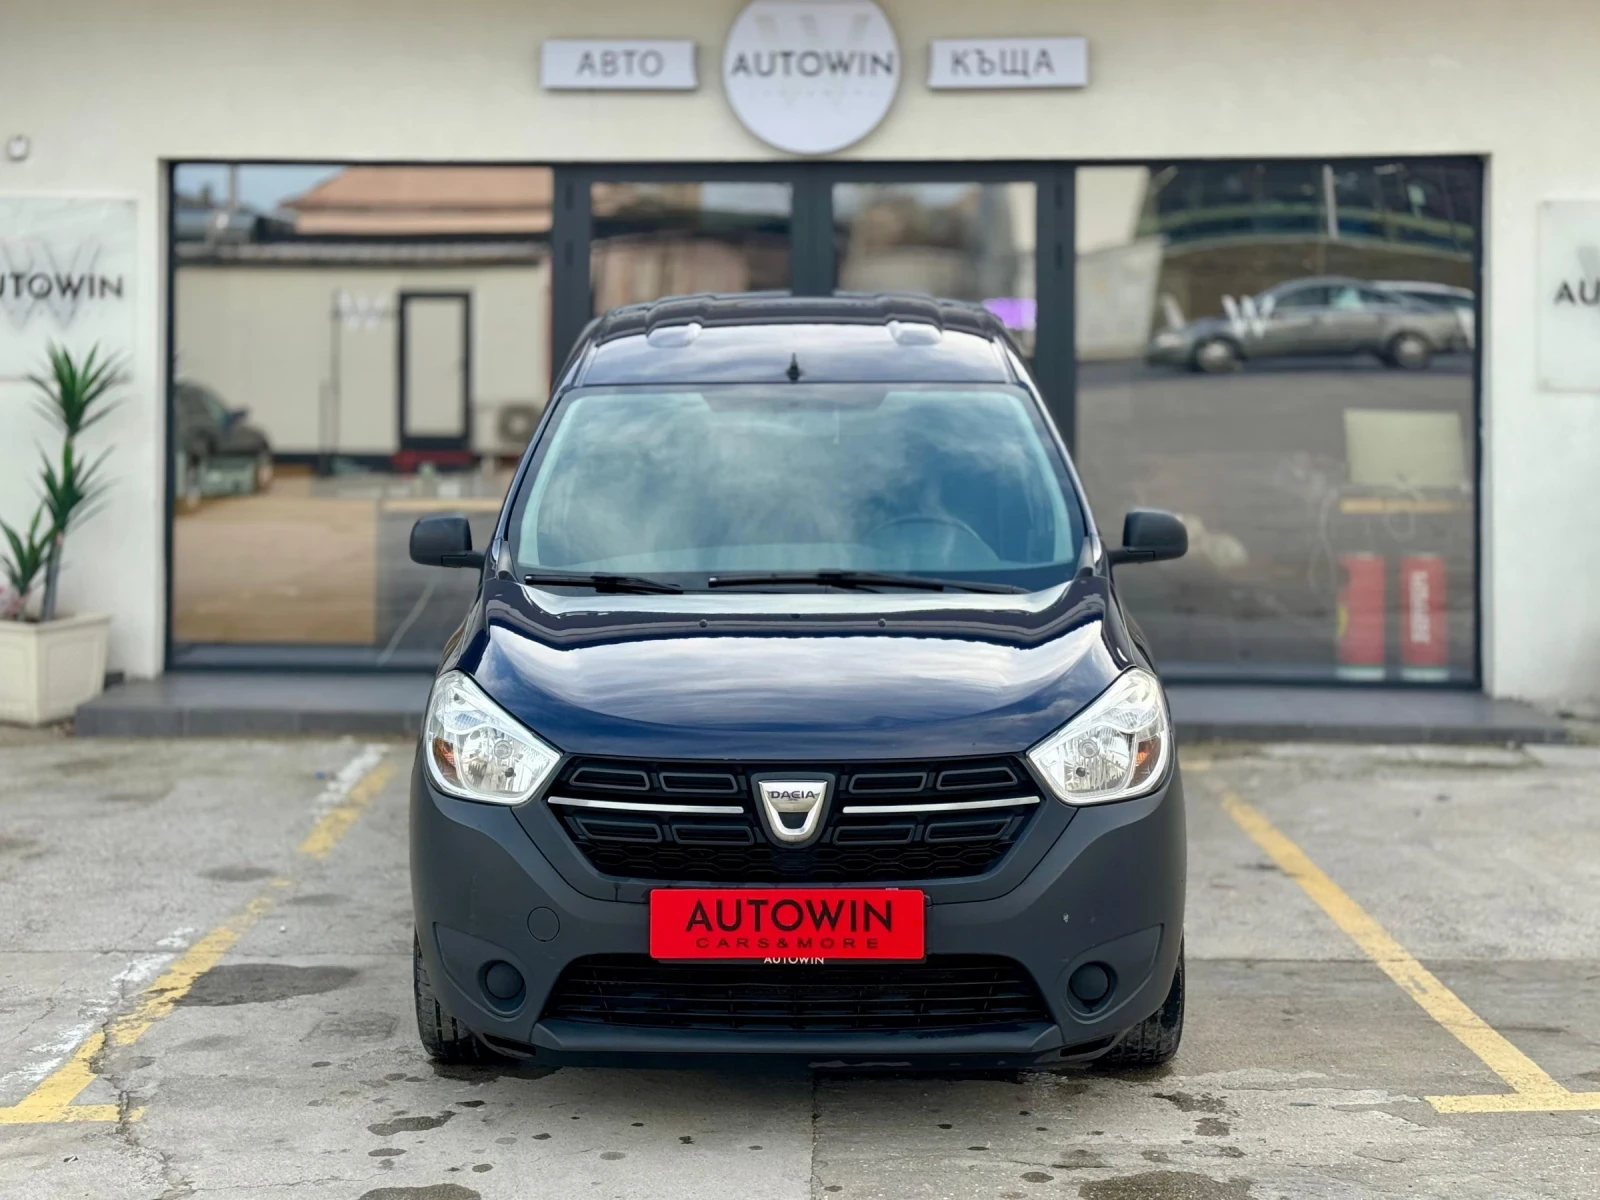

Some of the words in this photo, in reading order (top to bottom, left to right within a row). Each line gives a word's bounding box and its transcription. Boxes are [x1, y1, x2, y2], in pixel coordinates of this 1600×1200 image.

[576, 50, 664, 77] АВТО
[731, 50, 894, 77] AUTOWIN
[951, 48, 1055, 78] КЪЩА
[0, 272, 124, 301] TOWIN
[770, 790, 816, 799] DACIA
[685, 898, 893, 933] AUTOWIN
